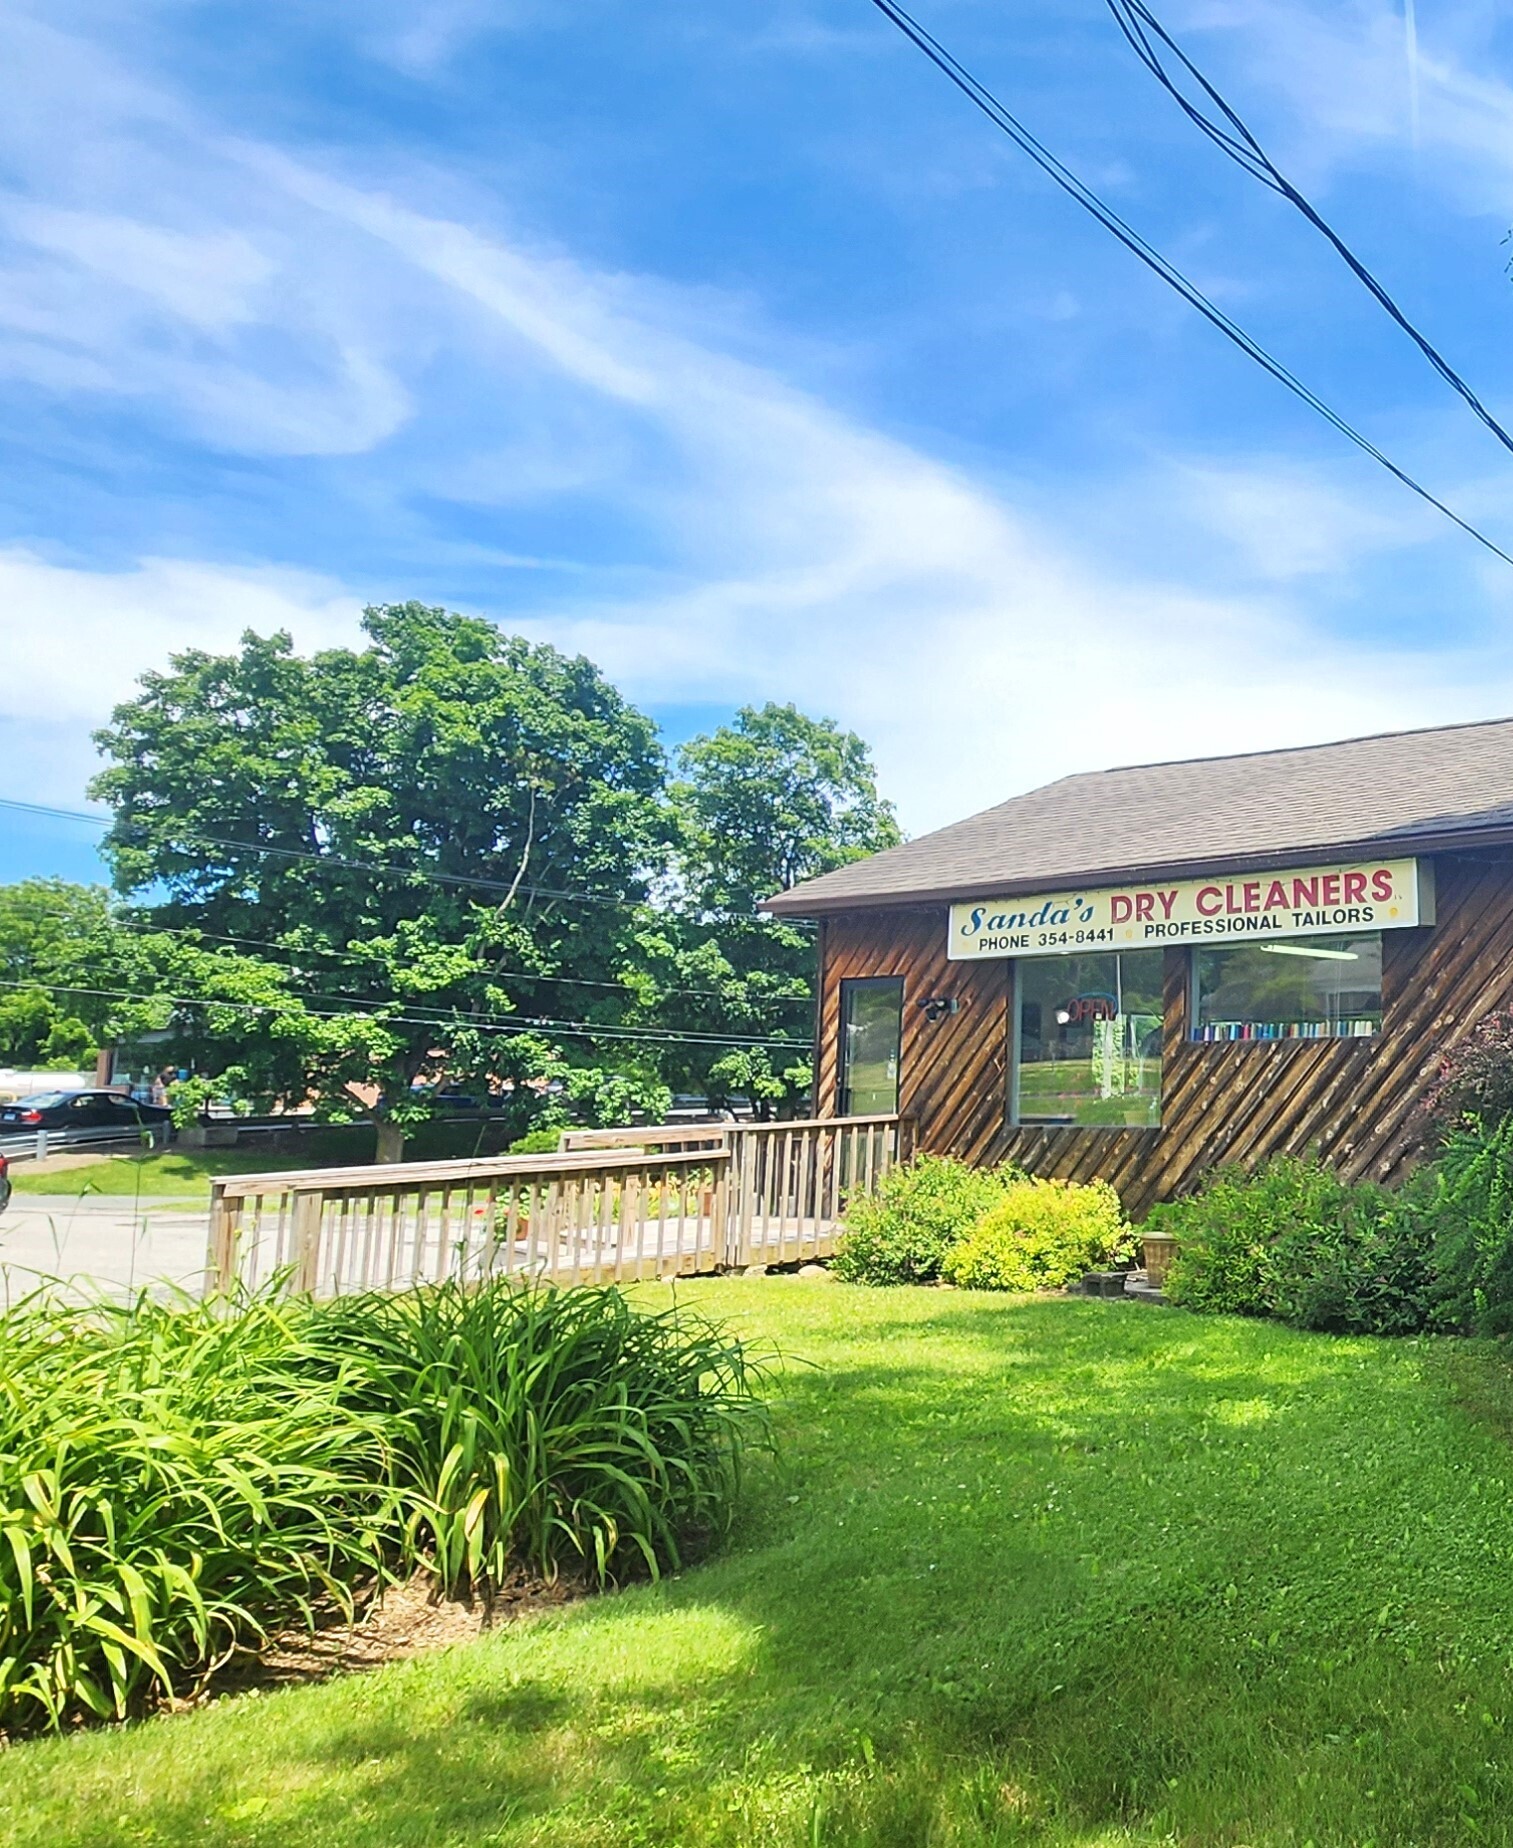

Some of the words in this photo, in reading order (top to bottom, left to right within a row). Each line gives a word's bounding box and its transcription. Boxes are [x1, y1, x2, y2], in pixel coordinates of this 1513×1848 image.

[961, 898, 1094, 937] Sanda's
[1111, 889, 1178, 925] DRY
[1196, 869, 1393, 917] CLEANERS
[1144, 914, 1282, 938] PROFESSIONAL
[1292, 906, 1374, 928] TAILORS
[979, 934, 1030, 951] PHONE
[1038, 927, 1114, 947] 354-8441
[1066, 998, 1115, 1021] OPEN
